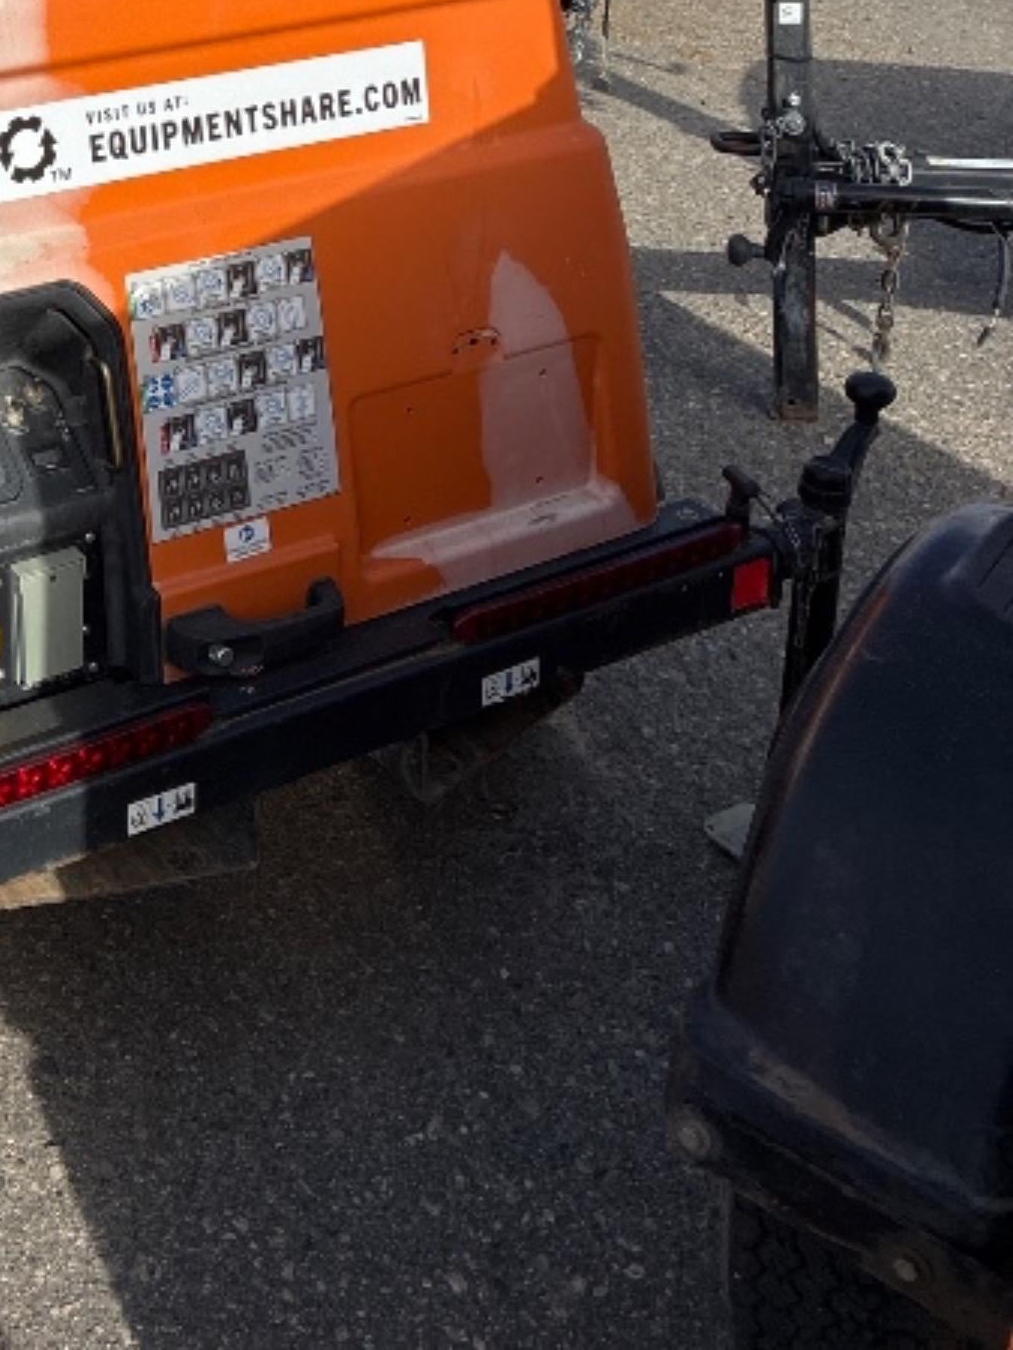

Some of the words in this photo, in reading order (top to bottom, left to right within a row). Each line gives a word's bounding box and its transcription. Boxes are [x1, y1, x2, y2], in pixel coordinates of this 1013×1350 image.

[86, 104, 130, 125] VISIT
[136, 100, 156, 116] US
[90, 77, 421, 163] EQUIPMENTSHARE.COM
[50, 167, 72, 183] TM
